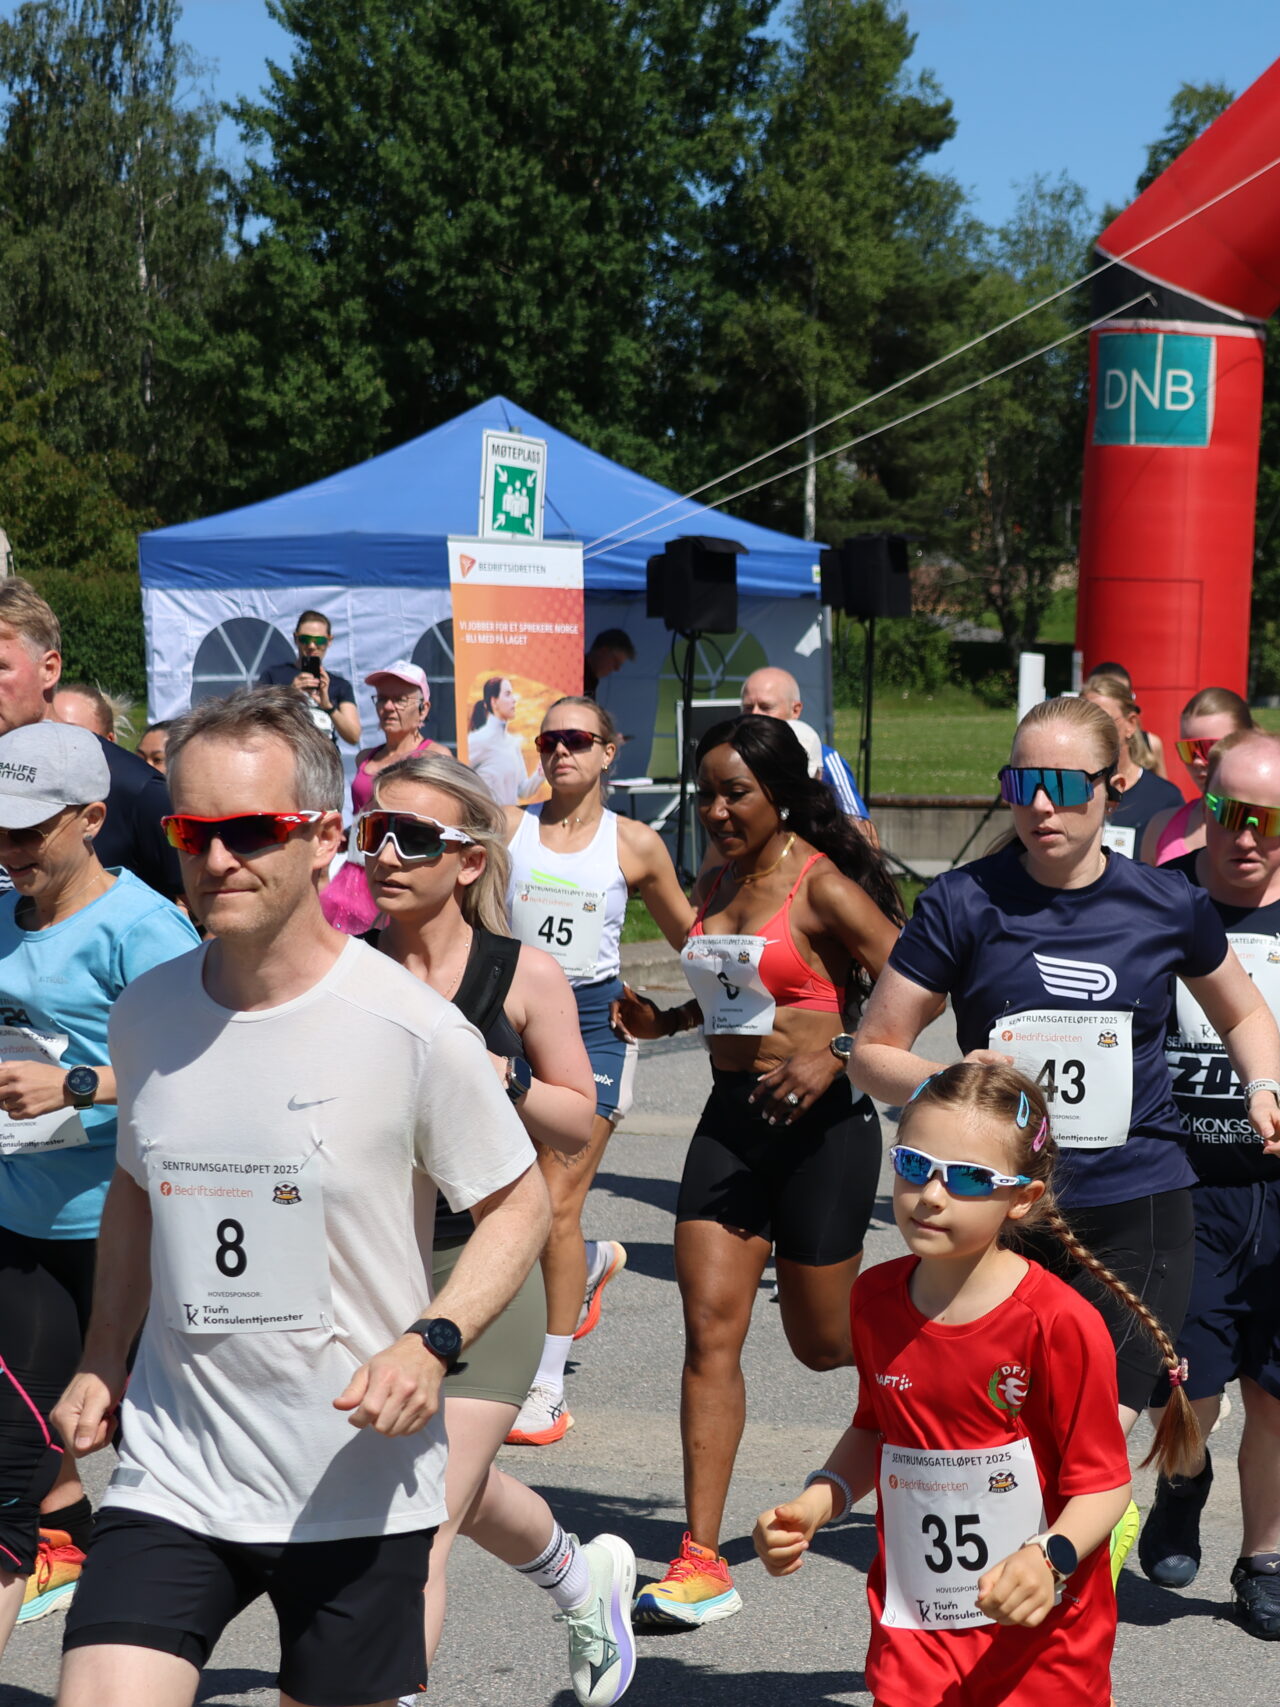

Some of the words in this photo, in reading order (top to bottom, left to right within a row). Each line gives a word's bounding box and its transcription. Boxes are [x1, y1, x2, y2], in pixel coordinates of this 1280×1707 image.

[492, 444, 540, 464] MØTEPLASS
[478, 562, 546, 574] BEDRIFTSIDRETTEN
[0, 771, 36, 783] ITION
[537, 915, 574, 947] 45
[1009, 1015, 1097, 1025] SENTRUMSGATELØPET
[1099, 1016, 1118, 1024] 2025
[1015, 1032, 1082, 1043] Bedriftsidretten
[1035, 1059, 1086, 1105] 43
[1053, 1134, 1108, 1143] ulenttjenester
[162, 1160, 270, 1174] SENTRUMSGATELØPET
[273, 1164, 299, 1174] 2025
[174, 1184, 253, 1198] Bedriftsidretten
[215, 1218, 247, 1278] 8
[203, 1313, 304, 1325] Konsulenttjenester
[1001, 1365, 1026, 1377] DFI
[875, 1373, 900, 1387] AFT
[892, 1452, 982, 1467] SENTRUMSGATELØPET
[986, 1452, 1012, 1464] 2025
[900, 1478, 968, 1492] Bedriftsidretten
[921, 1513, 989, 1574] 35
[935, 1585, 980, 1594] HOVEDSPONS
